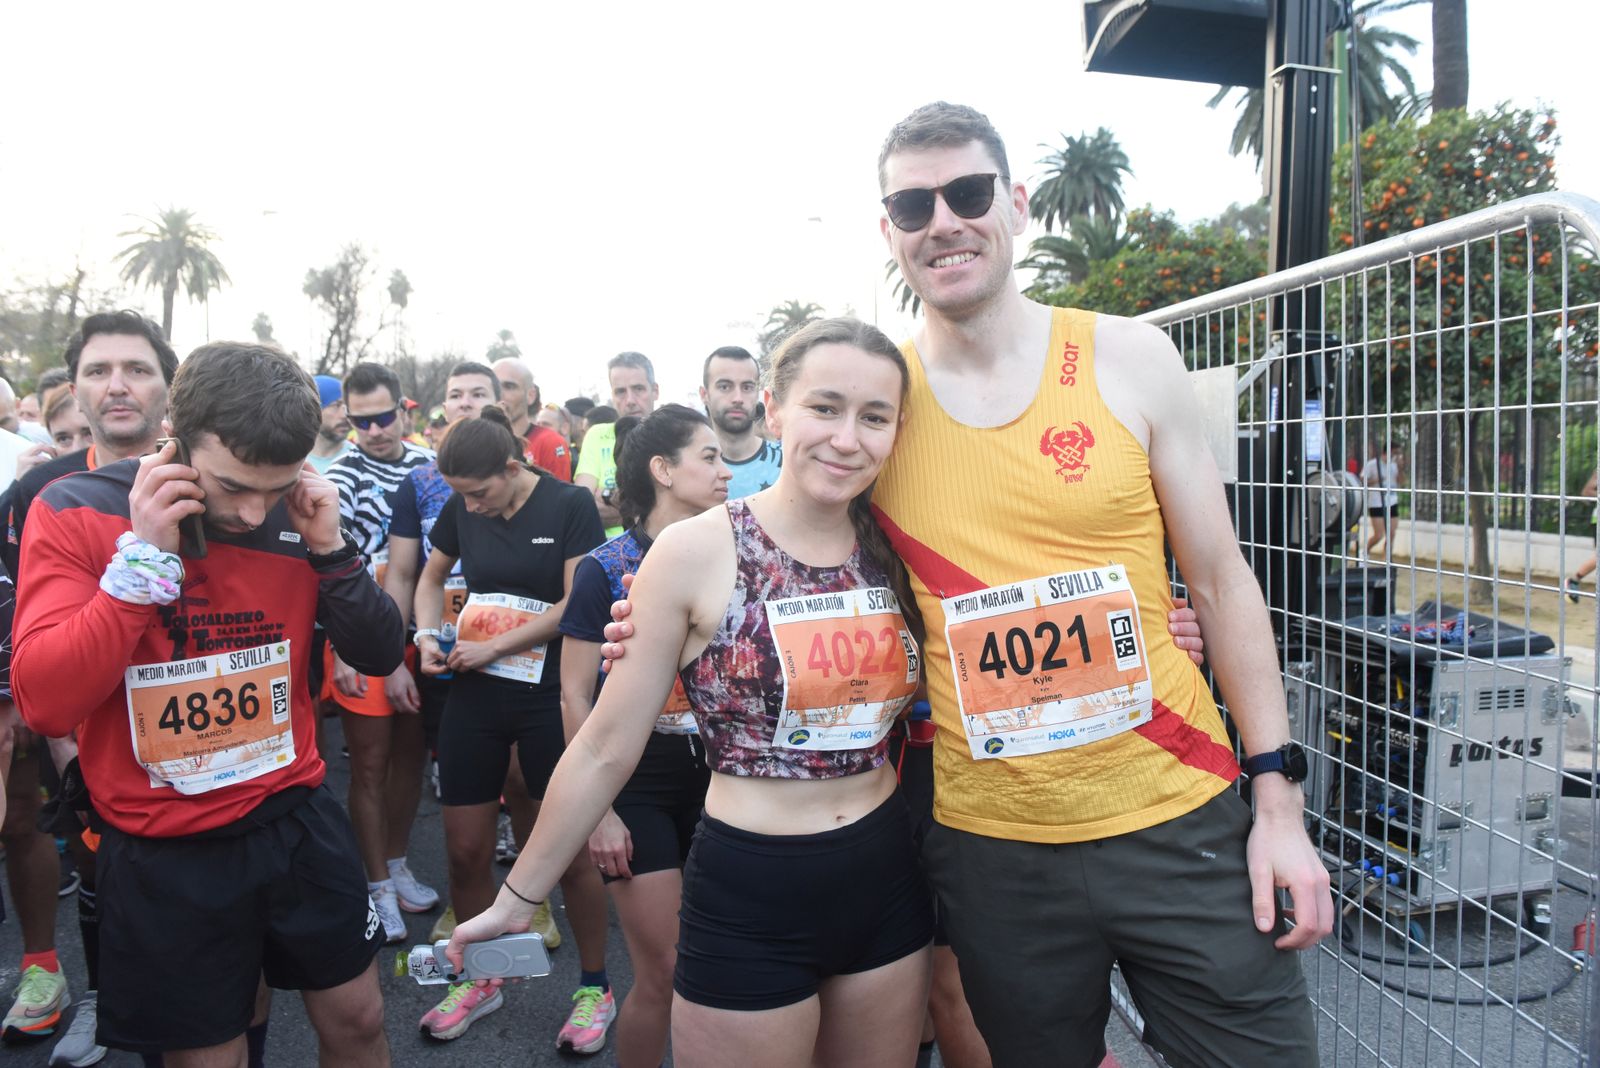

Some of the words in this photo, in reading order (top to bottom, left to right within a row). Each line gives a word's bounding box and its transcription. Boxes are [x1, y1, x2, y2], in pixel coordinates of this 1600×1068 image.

[1060, 342, 1079, 386] soar
[954, 596, 979, 616] MEDIO
[981, 586, 1024, 610] MARATÓN
[1047, 571, 1104, 600] SEVILLA
[518, 597, 543, 613] SEVILLA
[776, 600, 804, 617] MEDIO
[805, 594, 845, 612] MARATÓN
[807, 626, 900, 679] 4022
[979, 614, 1092, 680] 4021
[138, 666, 165, 681] MEDIO
[166, 659, 208, 678] MARATÓN
[229, 646, 271, 670] SEVILLA
[850, 679, 869, 687] Clara
[1033, 675, 1053, 686] Kyle
[1031, 693, 1063, 704] Spelman
[158, 682, 260, 735] 4836
[197, 728, 233, 740] MARCOS
[849, 730, 872, 740] HOKA
[1048, 728, 1076, 741] HOKA
[213, 770, 237, 782] HOKA
